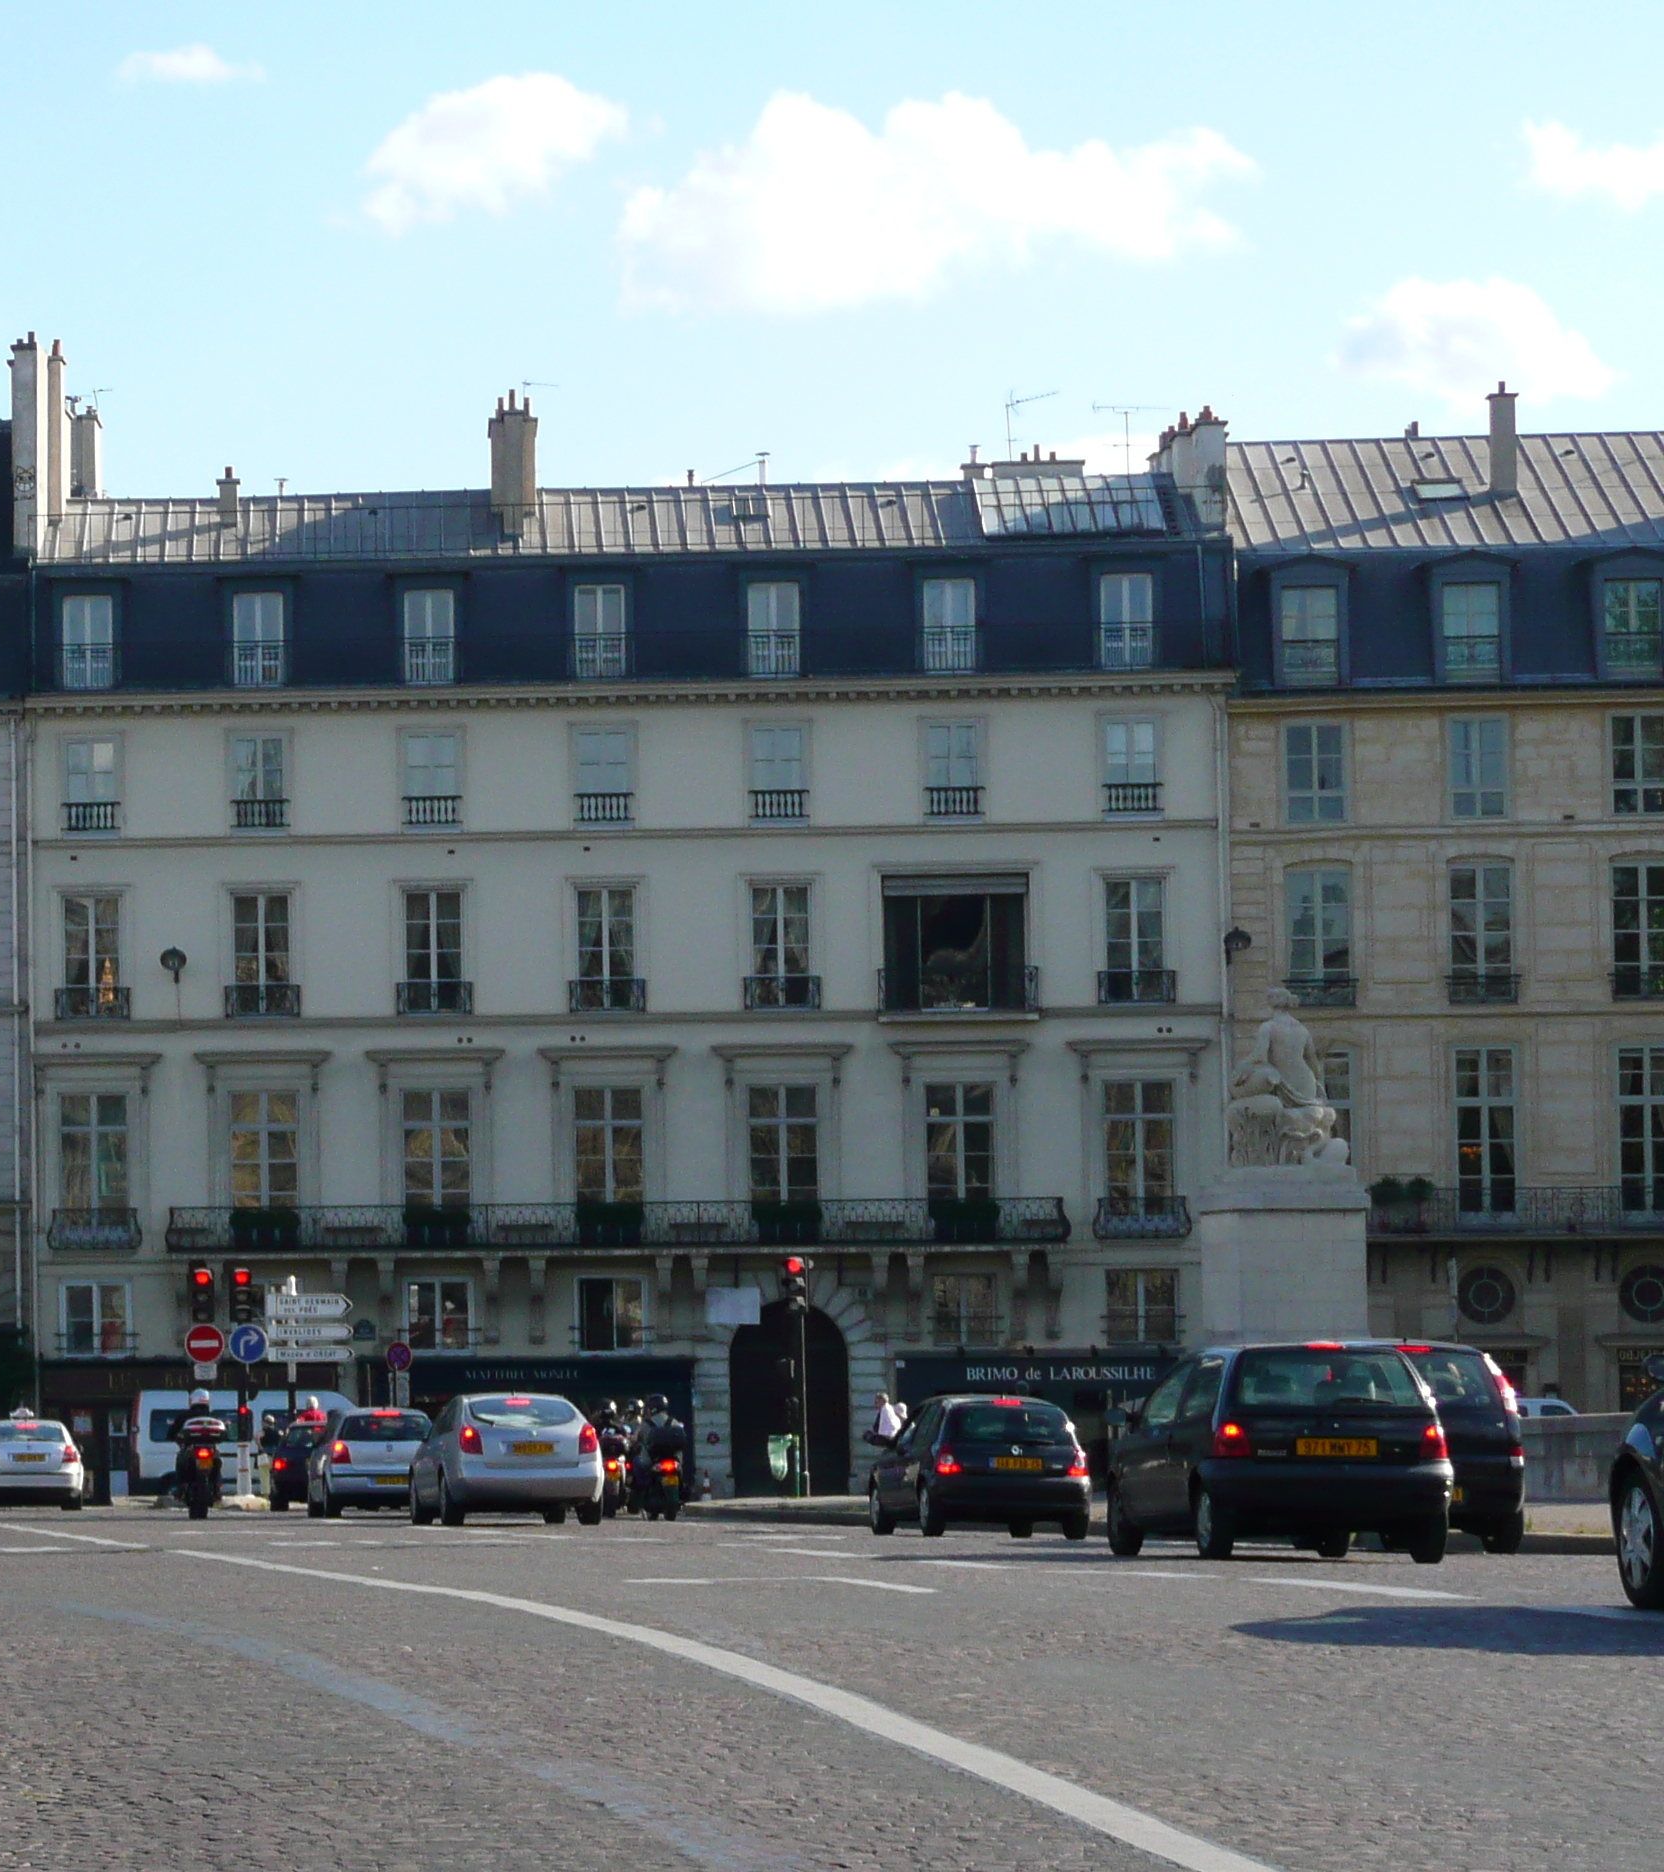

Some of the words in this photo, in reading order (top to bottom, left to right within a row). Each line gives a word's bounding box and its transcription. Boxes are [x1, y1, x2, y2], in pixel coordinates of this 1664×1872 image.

[279, 1328, 322, 1336] INVALIDES
[966, 1367, 1019, 1381] BRIMO
[1025, 1367, 1042, 1380] de
[1050, 1366, 1157, 1381] LAROUSSILHE
